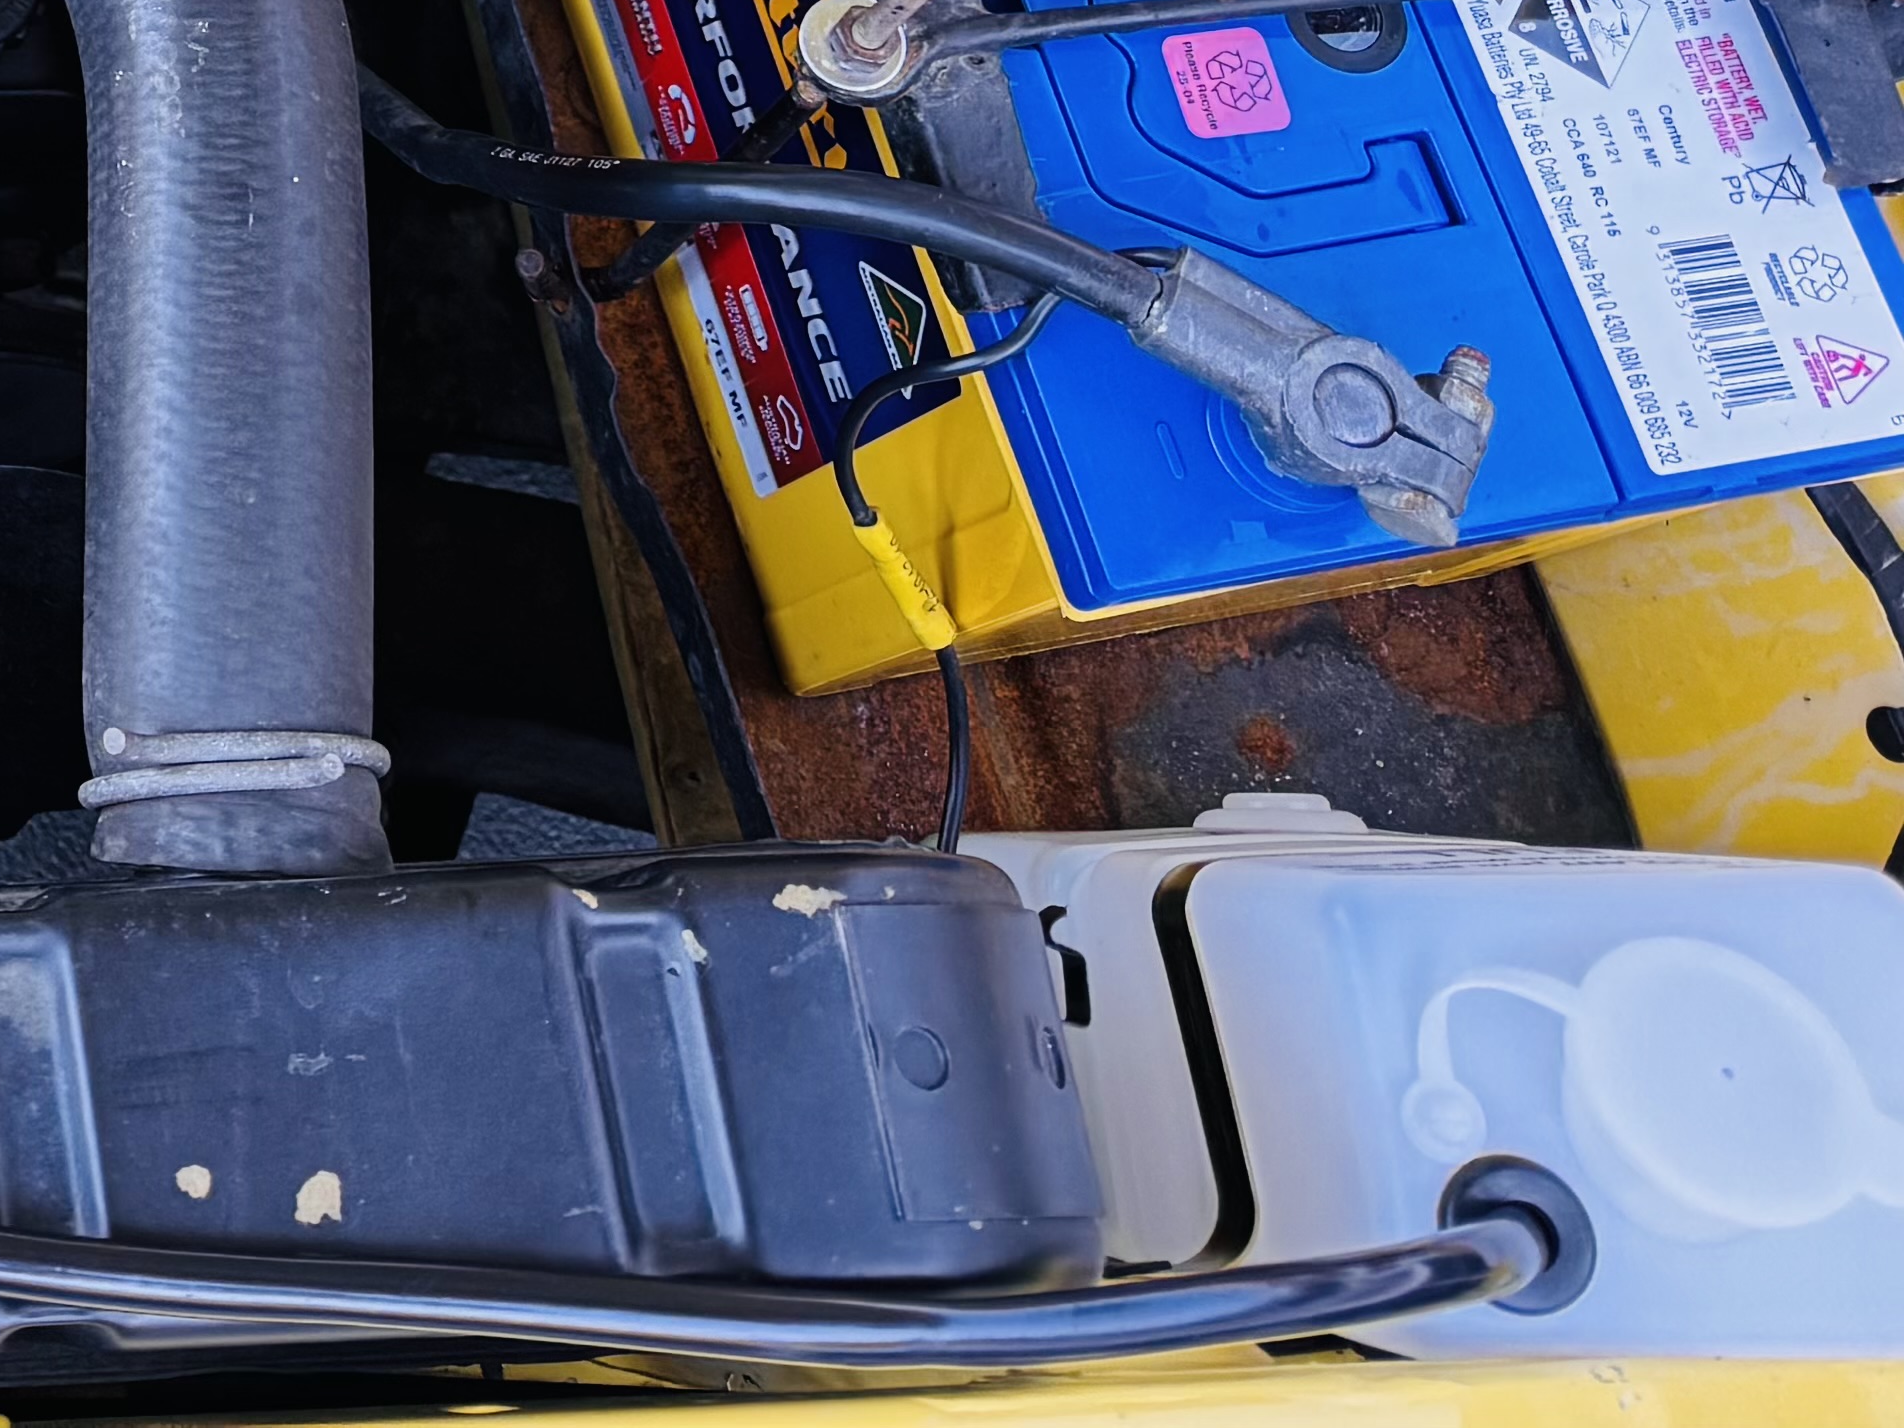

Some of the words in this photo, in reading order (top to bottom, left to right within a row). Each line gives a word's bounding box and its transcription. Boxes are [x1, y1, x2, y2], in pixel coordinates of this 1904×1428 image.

[1516, 19, 1538, 34] 8
[1479, 30, 1520, 81] Batteries
[1674, 37, 1714, 97] ELECTRIC
[1180, 39, 1203, 82] Please
[1193, 82, 1219, 132] Recycle
[1496, 79, 1530, 103] Pty
[1527, 70, 1556, 104] 2794
[1692, 34, 1725, 76] FILLED
[1712, 77, 1741, 110] WITH
[1727, 110, 1755, 142] ACID
[1508, 99, 1537, 121] Ltd
[1518, 120, 1553, 157] 49-65
[1559, 116, 1586, 150] CCA
[1590, 112, 1624, 165] 107121
[1651, 103, 1696, 167] Century
[518, 151, 544, 163] SAE
[1574, 151, 1598, 179] 640
[1640, 147, 1663, 170] MF
[1533, 156, 1569, 194] Cobalt
[1720, 174, 1749, 207] Pb
[1588, 184, 1611, 208] RC
[1546, 193, 1586, 234] Street,
[1598, 211, 1622, 238] 115
[1644, 224, 1662, 237] 9
[1565, 232, 1602, 272] Carole
[1581, 270, 1614, 300] Park
[1652, 249, 1697, 323] 313857
[1598, 311, 1632, 345] 4300
[703, 317, 733, 384] 67EF
[728, 387, 752, 429] MF
[1612, 343, 1644, 373] ABN
[1684, 328, 1730, 402] 332172
[1624, 371, 1652, 391] 66
[1631, 389, 1662, 416] 009
[1673, 398, 1700, 432] 12V
[1641, 415, 1673, 442] 685
[1652, 440, 1683, 467] 232
